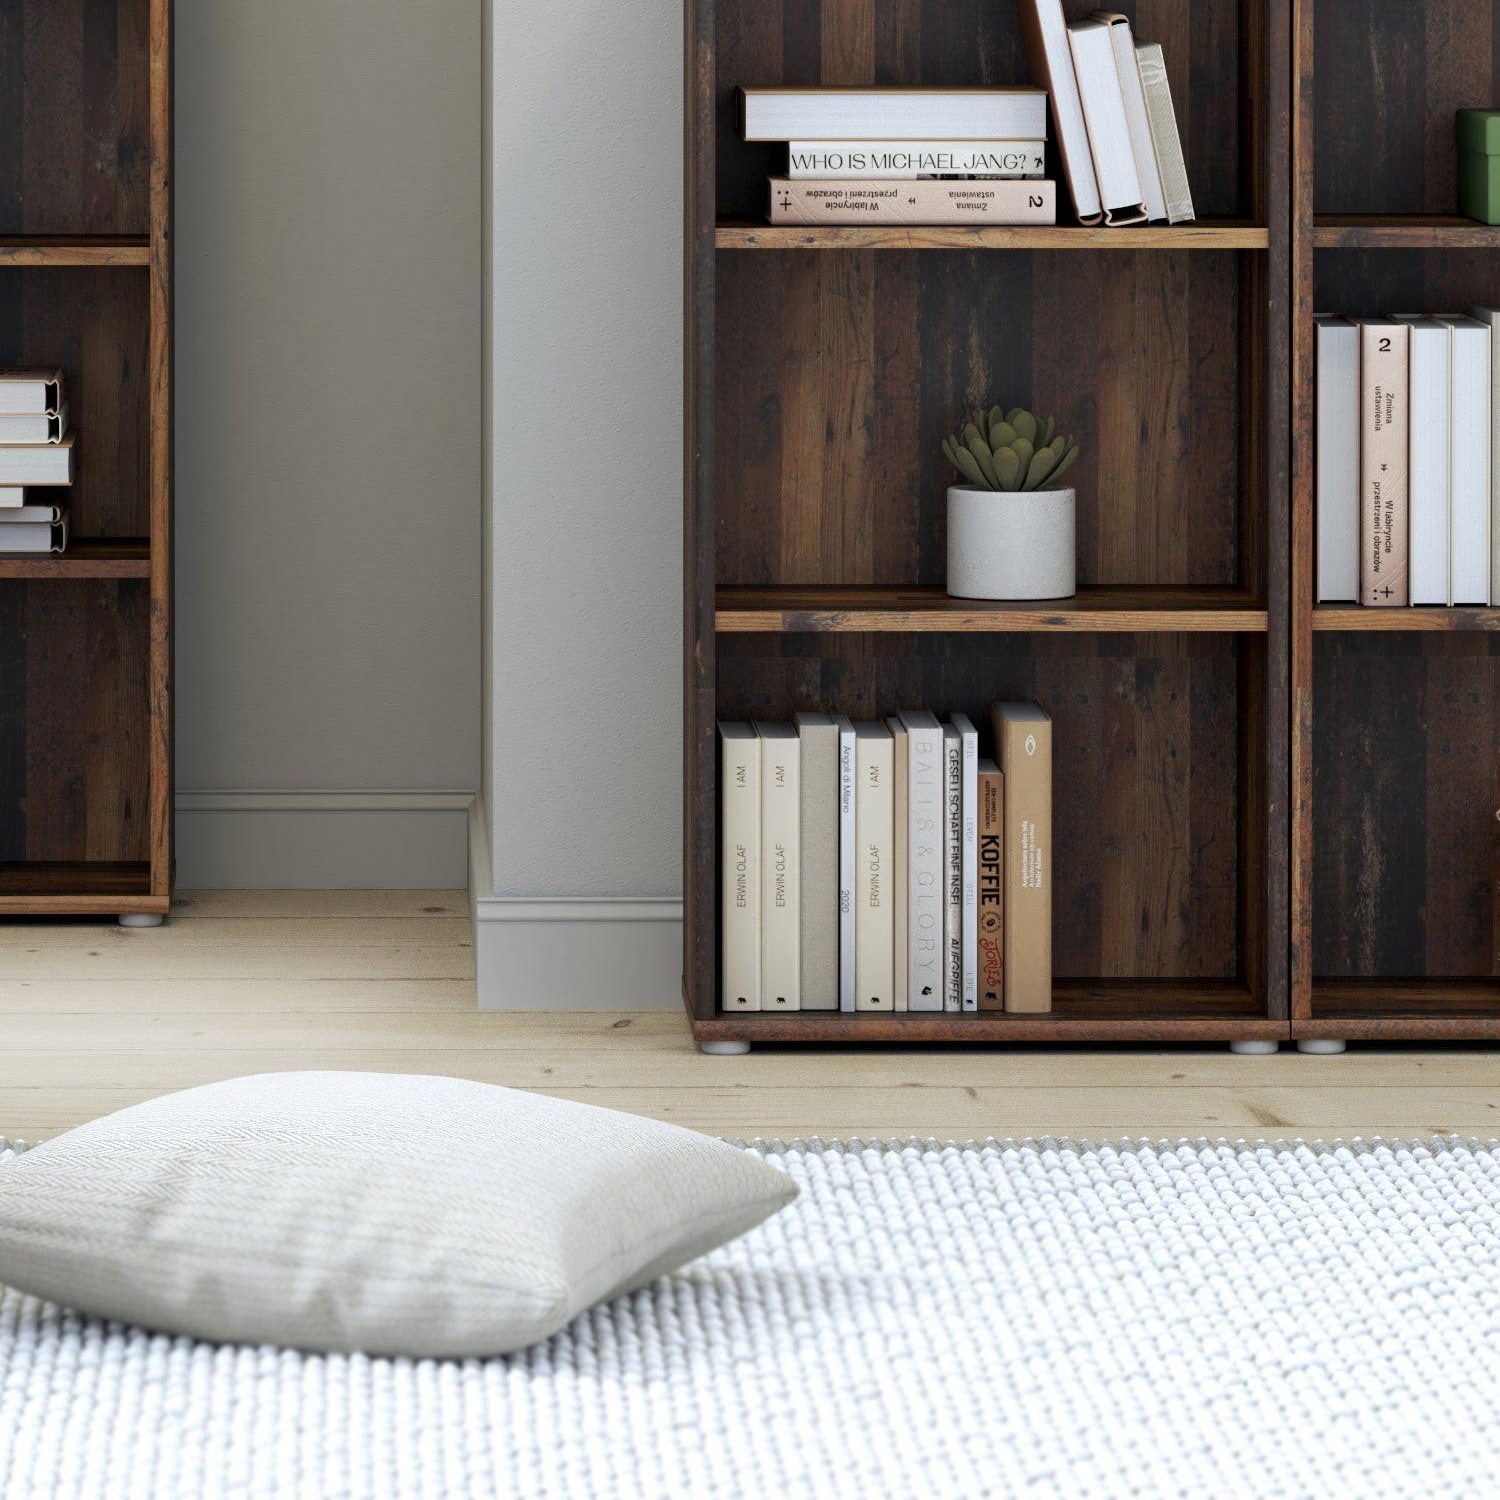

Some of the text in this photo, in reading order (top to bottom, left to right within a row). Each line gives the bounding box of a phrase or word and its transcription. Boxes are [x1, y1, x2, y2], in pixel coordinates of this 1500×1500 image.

[791, 153, 1026, 170] WHO IS MICHAEL JANG?
[806, 190, 843, 199] obrazów
[849, 188, 898, 199] przestrzeni
[949, 190, 995, 200] ustawienia
[825, 201, 879, 210] W labiryncie
[956, 202, 988, 210] Zmiana
[1029, 196, 1043, 208] 2
[1379, 338, 1391, 352] 2
[1386, 393, 1394, 424] Zmiana
[1373, 481, 1382, 530] przestrzeni
[1383, 501, 1393, 554] W labiryncie
[1373, 535, 1381, 572] obrazów
[842, 745, 850, 772] Angoli
[736, 766, 746, 782] AM
[776, 766, 784, 782] AM
[843, 775, 850, 783] di
[870, 766, 880, 782] AM
[737, 845, 746, 908] ERWIN OLAF
[776, 845, 785, 908] ERWIN OLAF
[870, 845, 880, 908] ERWIN OLAF
[981, 835, 999, 905] KOFFIE
[841, 890, 849, 913] 2020
